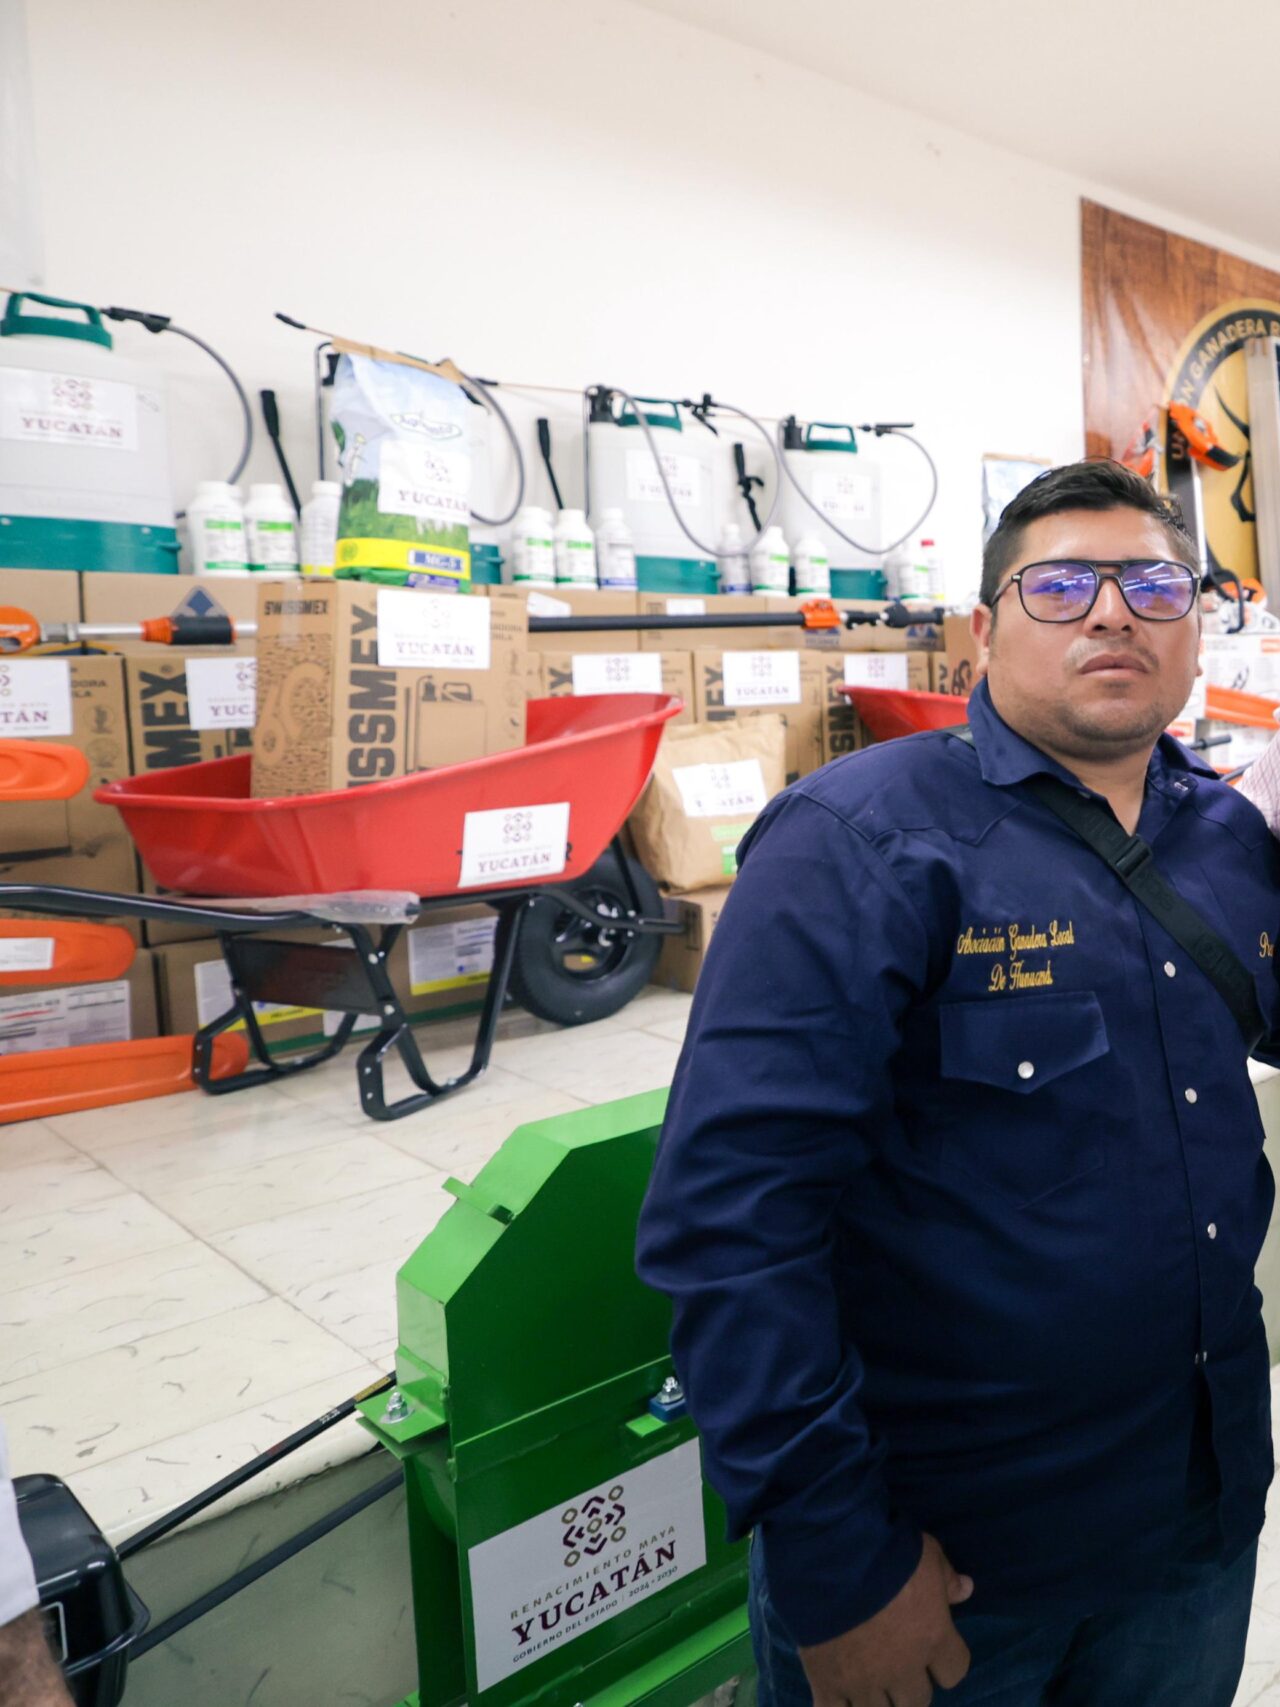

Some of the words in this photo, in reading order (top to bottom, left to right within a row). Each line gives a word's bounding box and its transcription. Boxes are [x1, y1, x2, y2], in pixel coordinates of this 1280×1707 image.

[1189, 318, 1268, 379] GANADERA
[1049, 919, 1075, 947] Local
[988, 963, 1006, 992] De
[510, 1548, 632, 1620] RENACIMIENTO
[638, 1525, 676, 1551] MAYA
[511, 1539, 677, 1647] YUCATÁN
[512, 1631, 563, 1663] GOBIERNO
[565, 1620, 582, 1634] DEL
[584, 1600, 619, 1623] ESTADO
[628, 1581, 650, 1598] 2024
[657, 1565, 678, 1582] 2030
